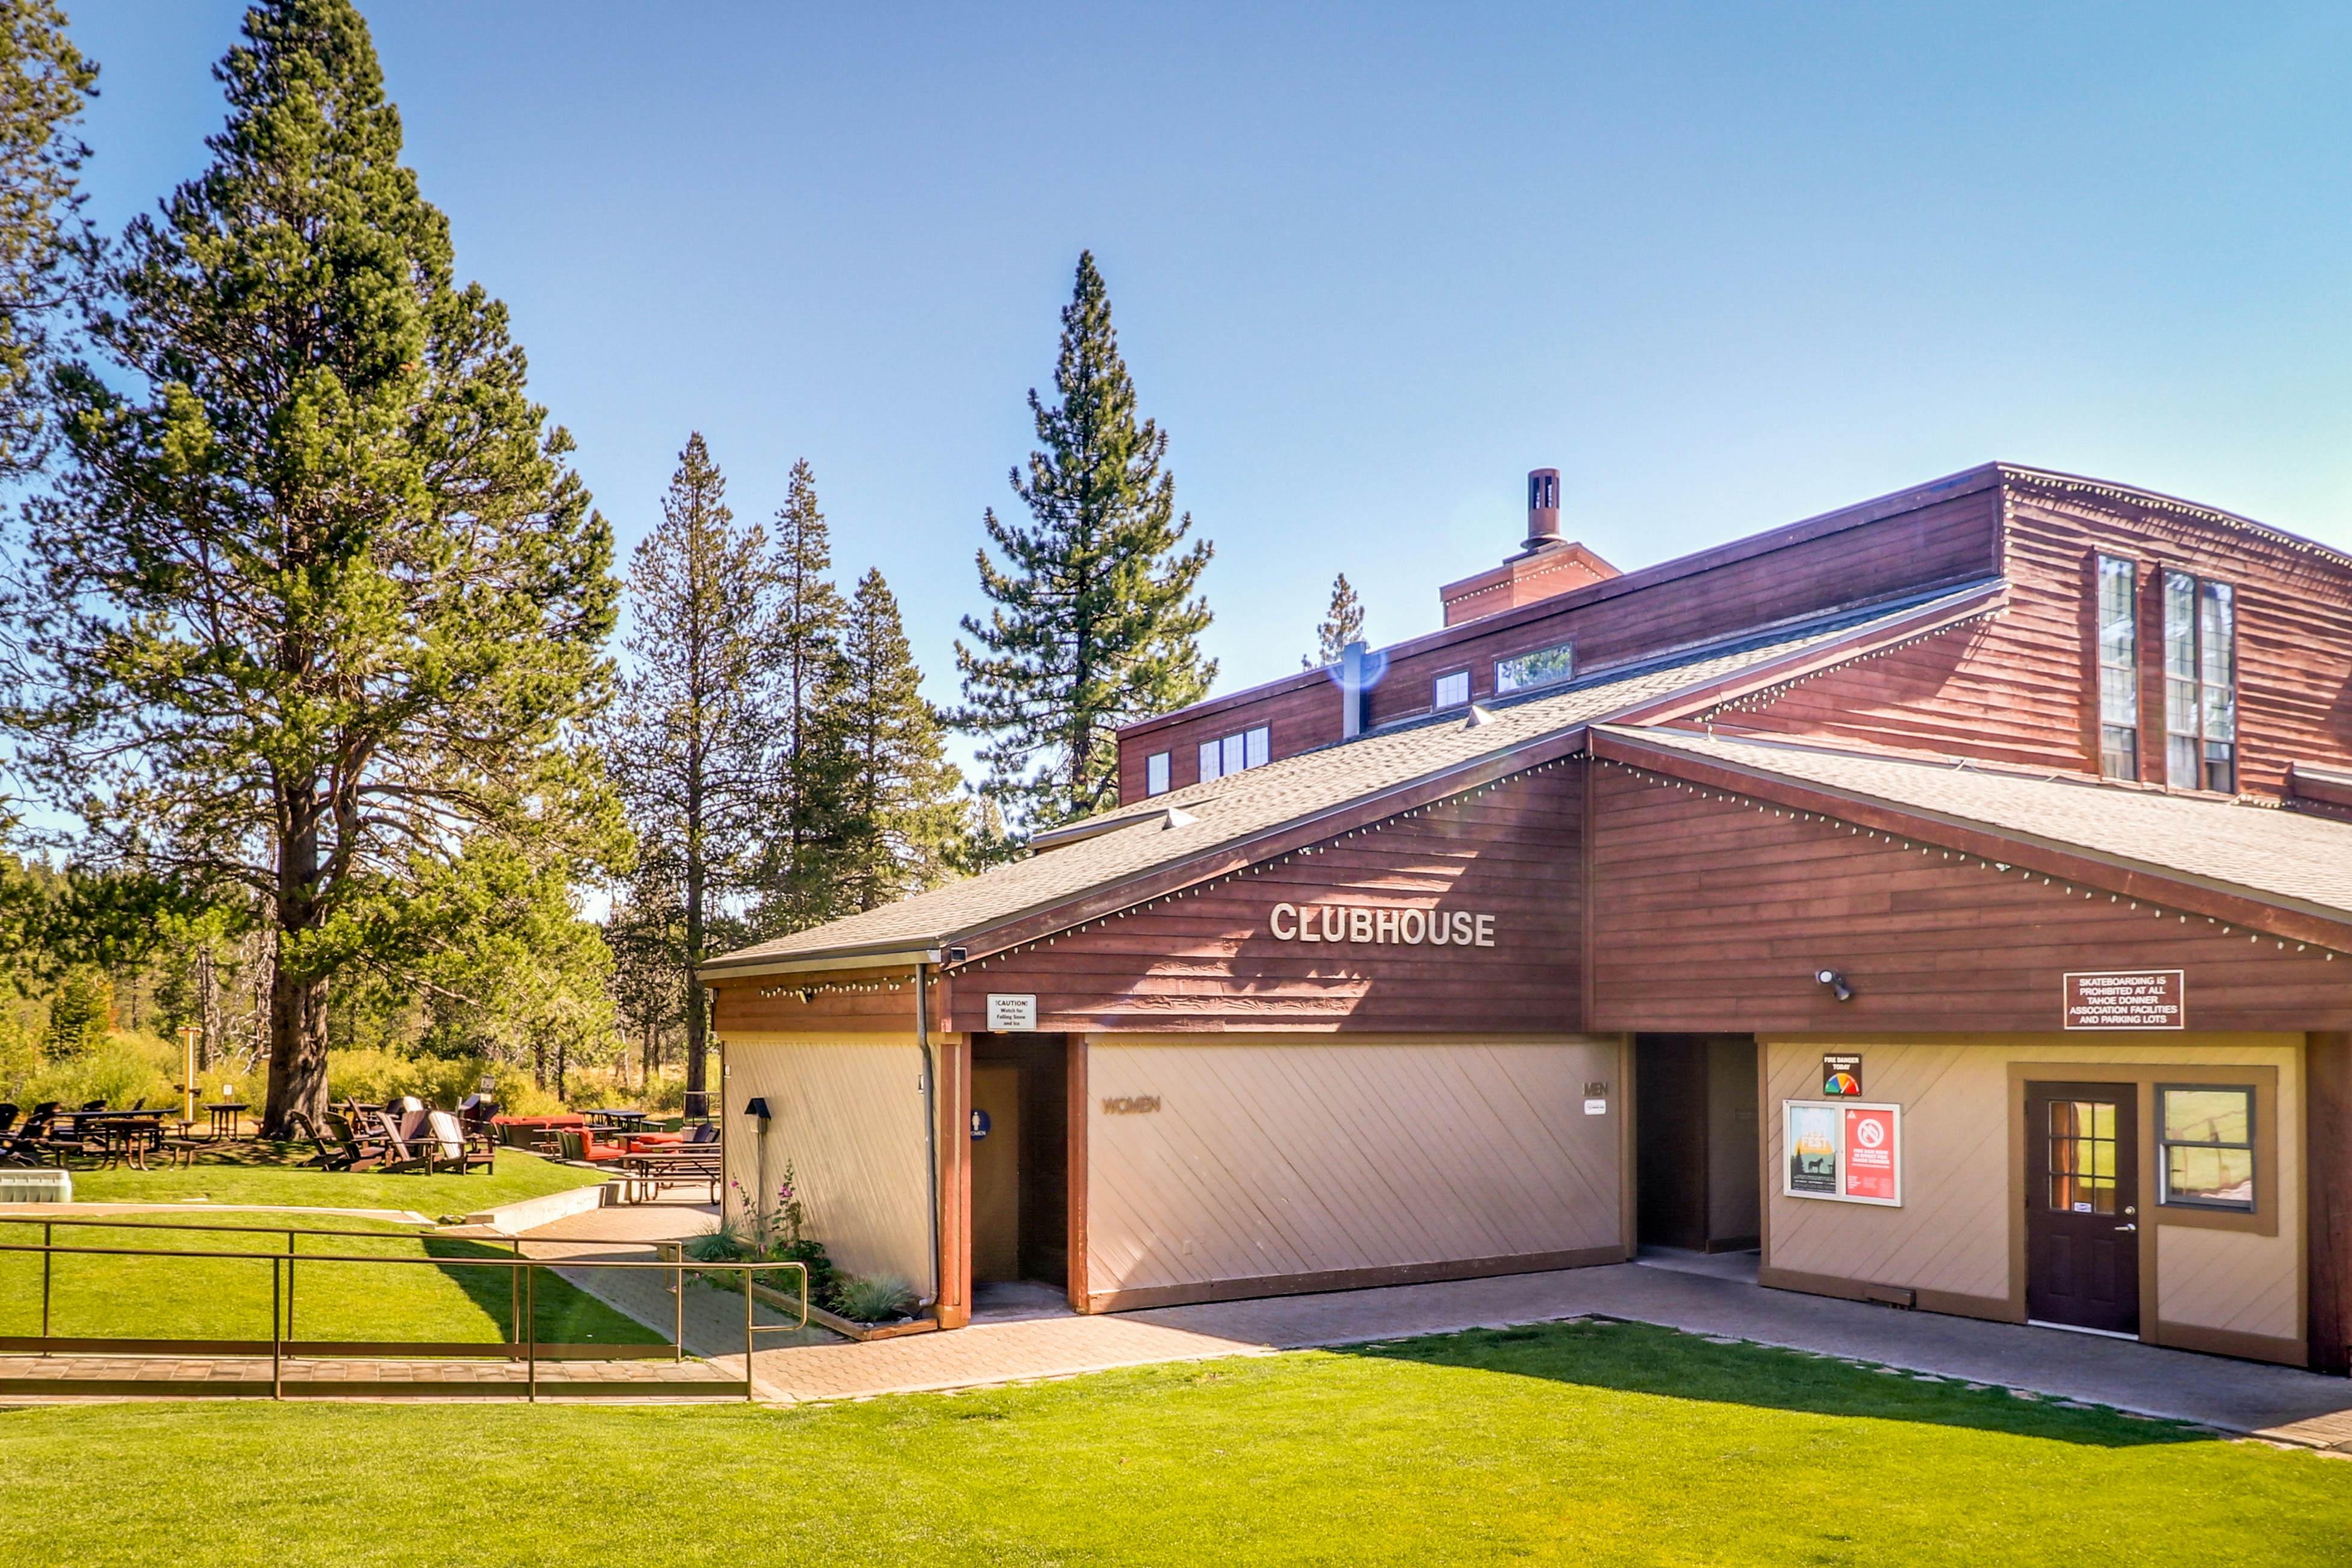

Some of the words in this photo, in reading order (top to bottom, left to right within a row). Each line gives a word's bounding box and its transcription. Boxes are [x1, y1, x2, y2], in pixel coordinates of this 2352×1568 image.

[1270, 902, 1495, 947] CLUBHOUSE
[2079, 977, 2155, 987] SKATEBOARDING
[2156, 976, 2167, 985] IS
[2079, 987, 2133, 996] PROHIBITED
[2134, 986, 2147, 994] AT
[2147, 986, 2166, 994] ALL
[2087, 996, 2117, 1005] TAHOE
[2118, 996, 2159, 1005] DONNER
[2069, 1005, 2128, 1014] ASSOCIATION
[2130, 1005, 2178, 1014] FACILITIES
[2100, 1015, 2141, 1023] PARKING
[2143, 1015, 2167, 1023] LOTS
[1583, 1082, 1608, 1097] MEN
[1102, 1095, 1161, 1115] WOMEN
[1801, 1136, 1828, 1149] FEST
